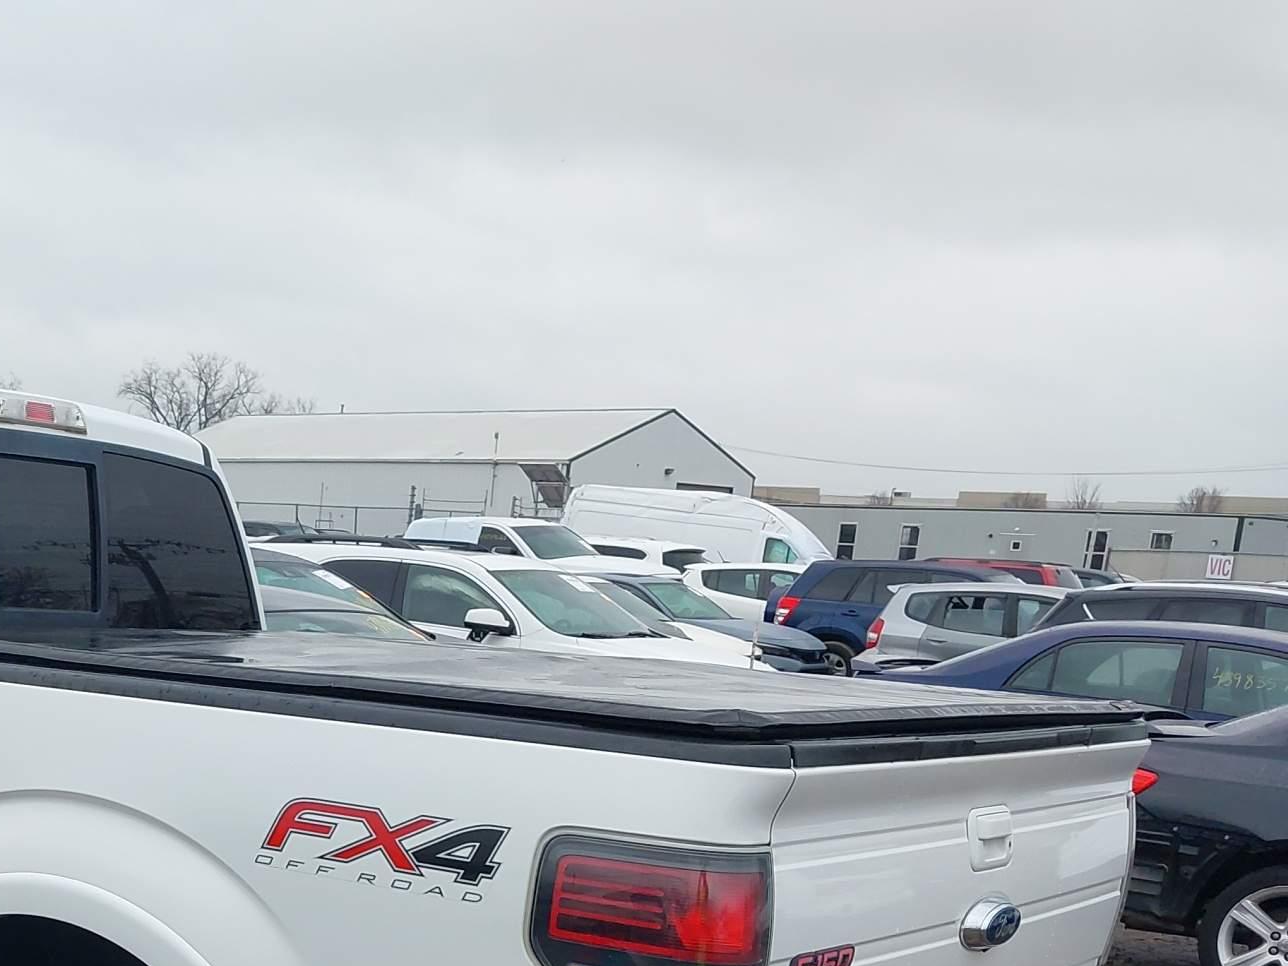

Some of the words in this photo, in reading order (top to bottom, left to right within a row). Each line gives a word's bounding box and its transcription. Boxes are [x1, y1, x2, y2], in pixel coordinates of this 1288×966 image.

[1209, 557, 1232, 577] VIC
[261, 797, 511, 887] FX4
[254, 854, 336, 876] OFF
[357, 872, 483, 903] ROAD
